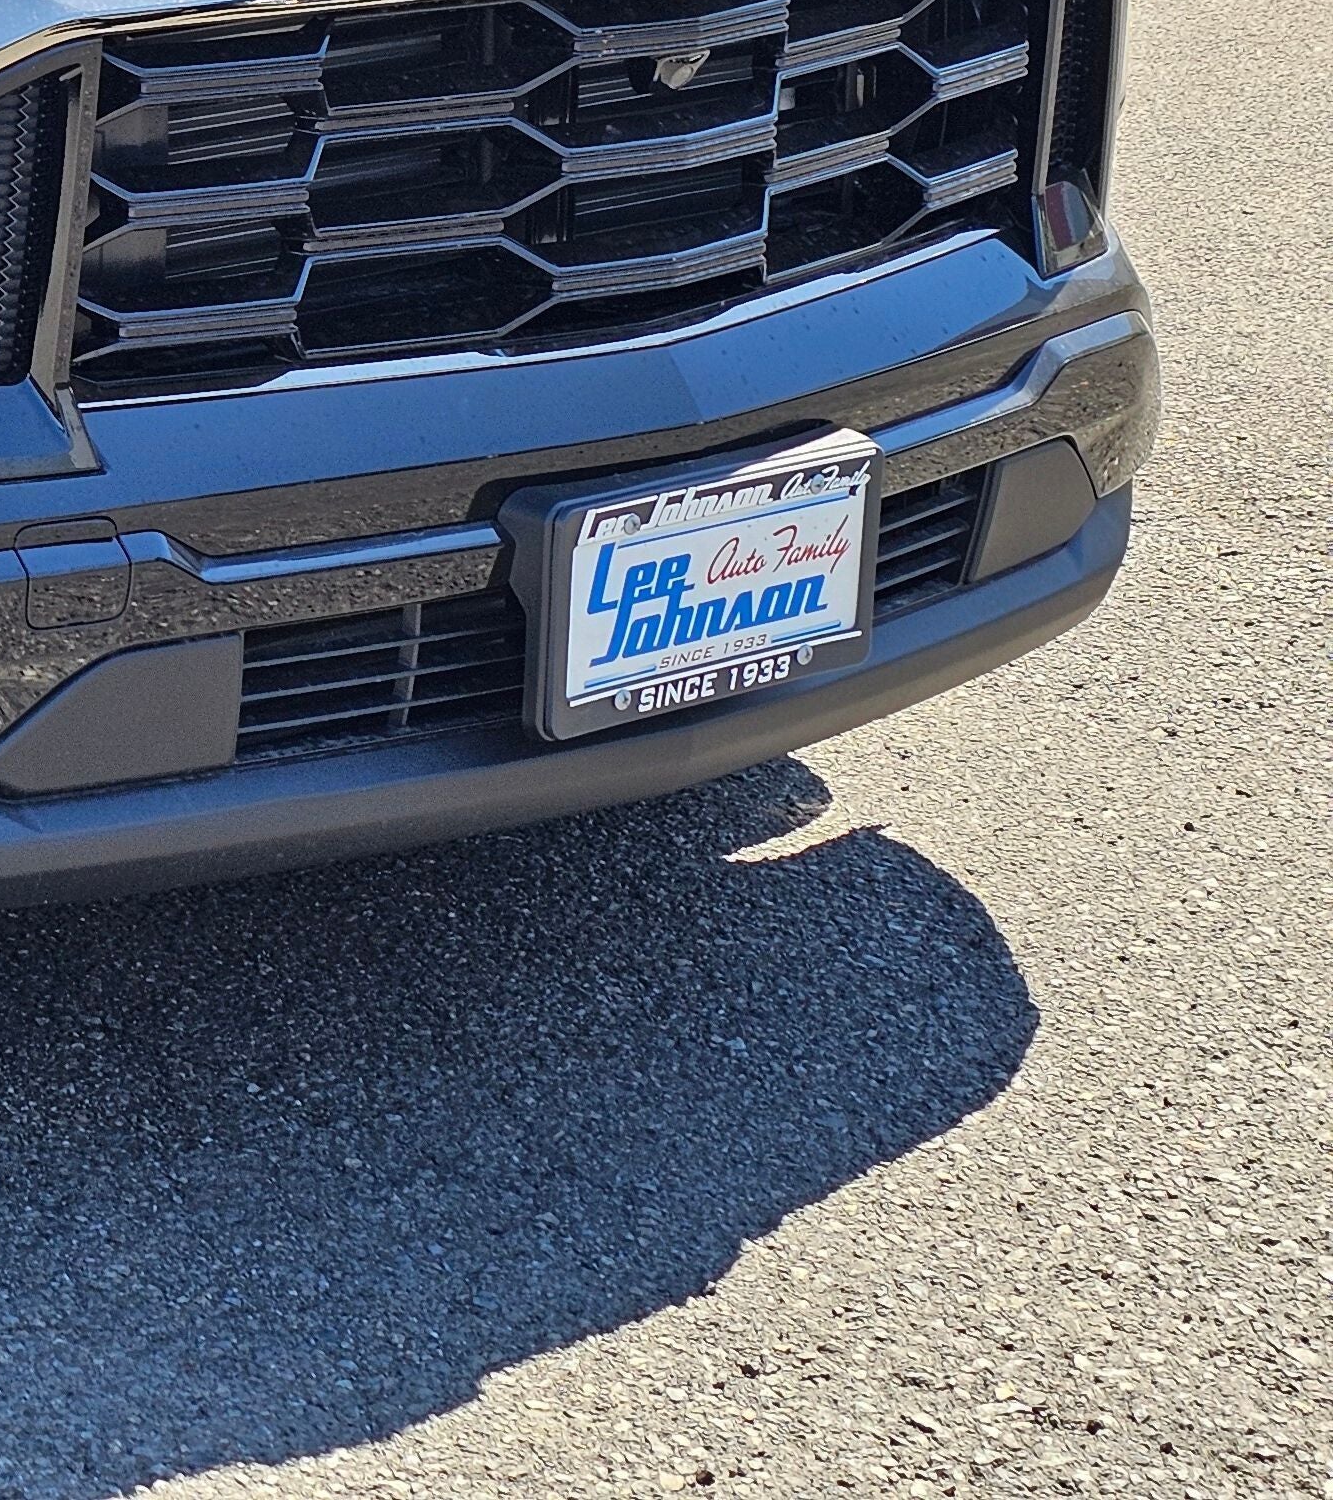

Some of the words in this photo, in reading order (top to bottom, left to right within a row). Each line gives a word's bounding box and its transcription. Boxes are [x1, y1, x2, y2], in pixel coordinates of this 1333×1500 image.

[639, 484, 774, 532] Johnson
[821, 459, 872, 497] Family
[587, 542, 695, 615] Lee
[707, 536, 767, 585] Auto
[772, 514, 852, 574] Family
[589, 574, 830, 669] Johnson
[658, 647, 714, 670] SINCE
[722, 633, 768, 655] 1933
[637, 672, 717, 713] SINCE
[727, 654, 791, 690] 1933
